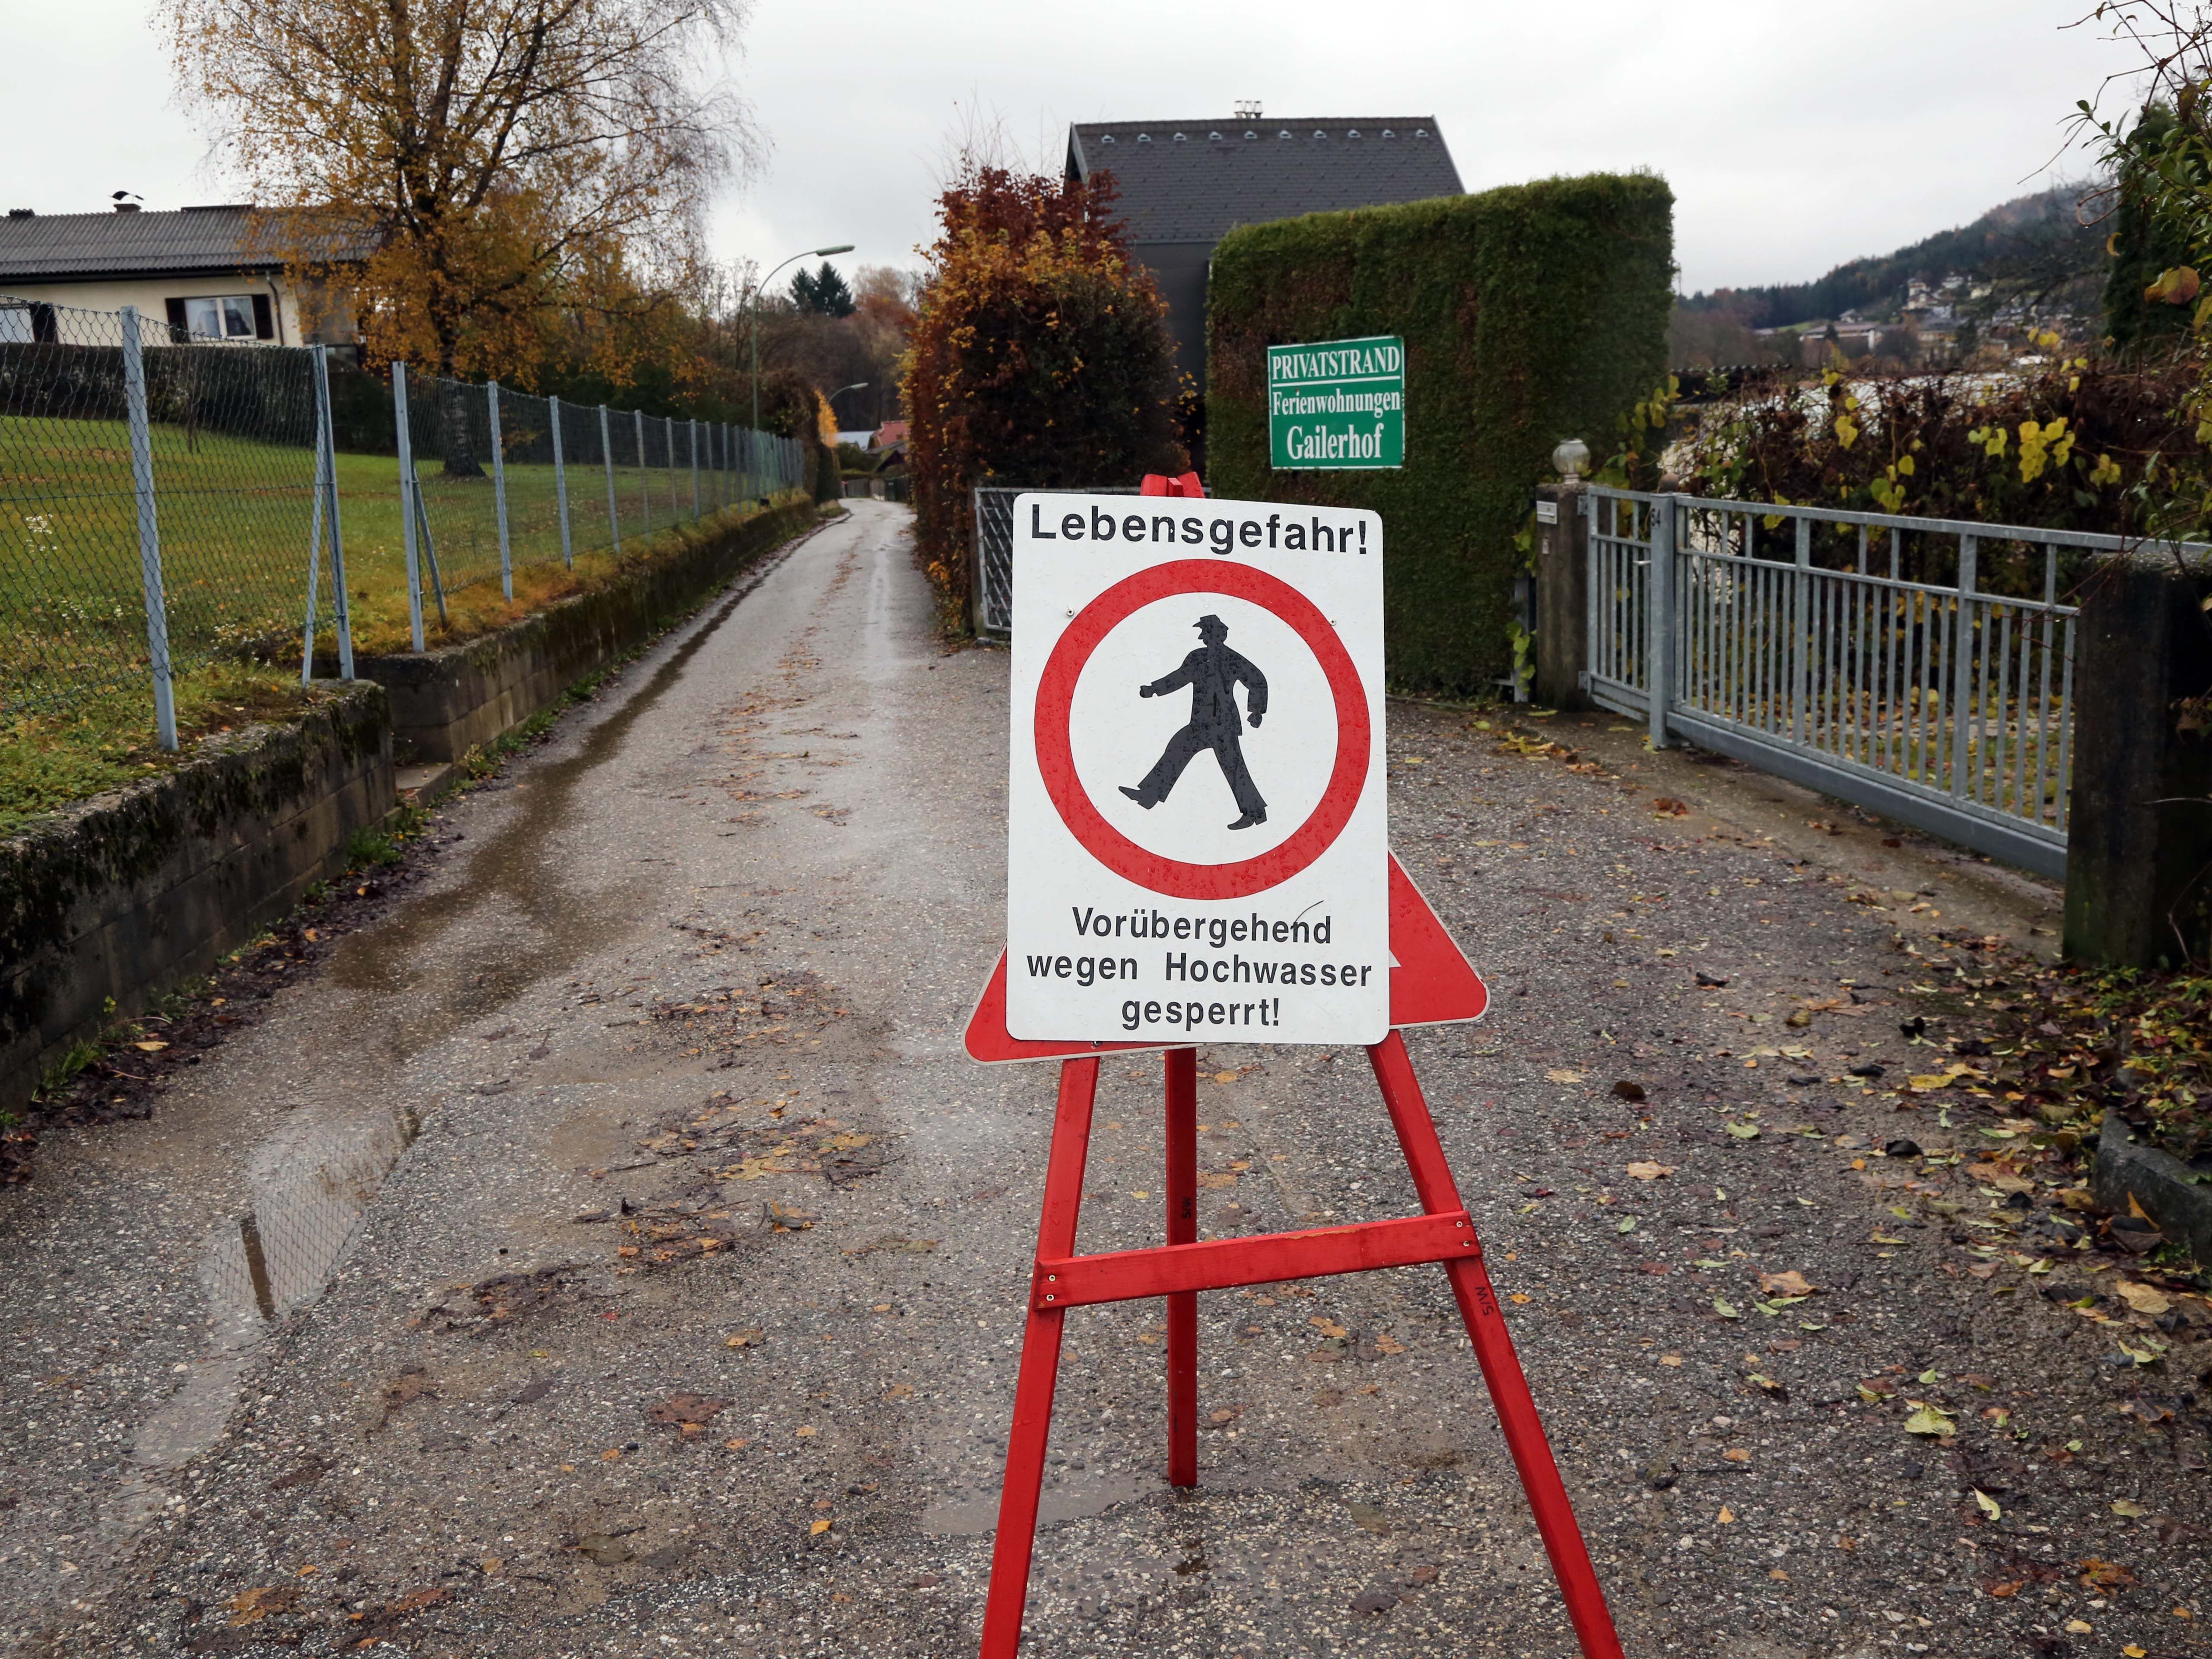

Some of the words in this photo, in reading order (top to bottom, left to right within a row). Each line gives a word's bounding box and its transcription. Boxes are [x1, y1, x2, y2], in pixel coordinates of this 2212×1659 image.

[1272, 346, 1400, 380] PRIVATSTRAND
[1272, 388, 1401, 418] Ferienwohnungen
[1287, 423, 1384, 460] Gailerhof
[1032, 504, 1367, 555] Lebensgefahr!
[1072, 907, 1331, 947] Vorübergehend
[1027, 955, 1137, 987] wegen
[1166, 952, 1372, 986] Hochwasser
[1122, 998, 1279, 1032] gesperrt!
